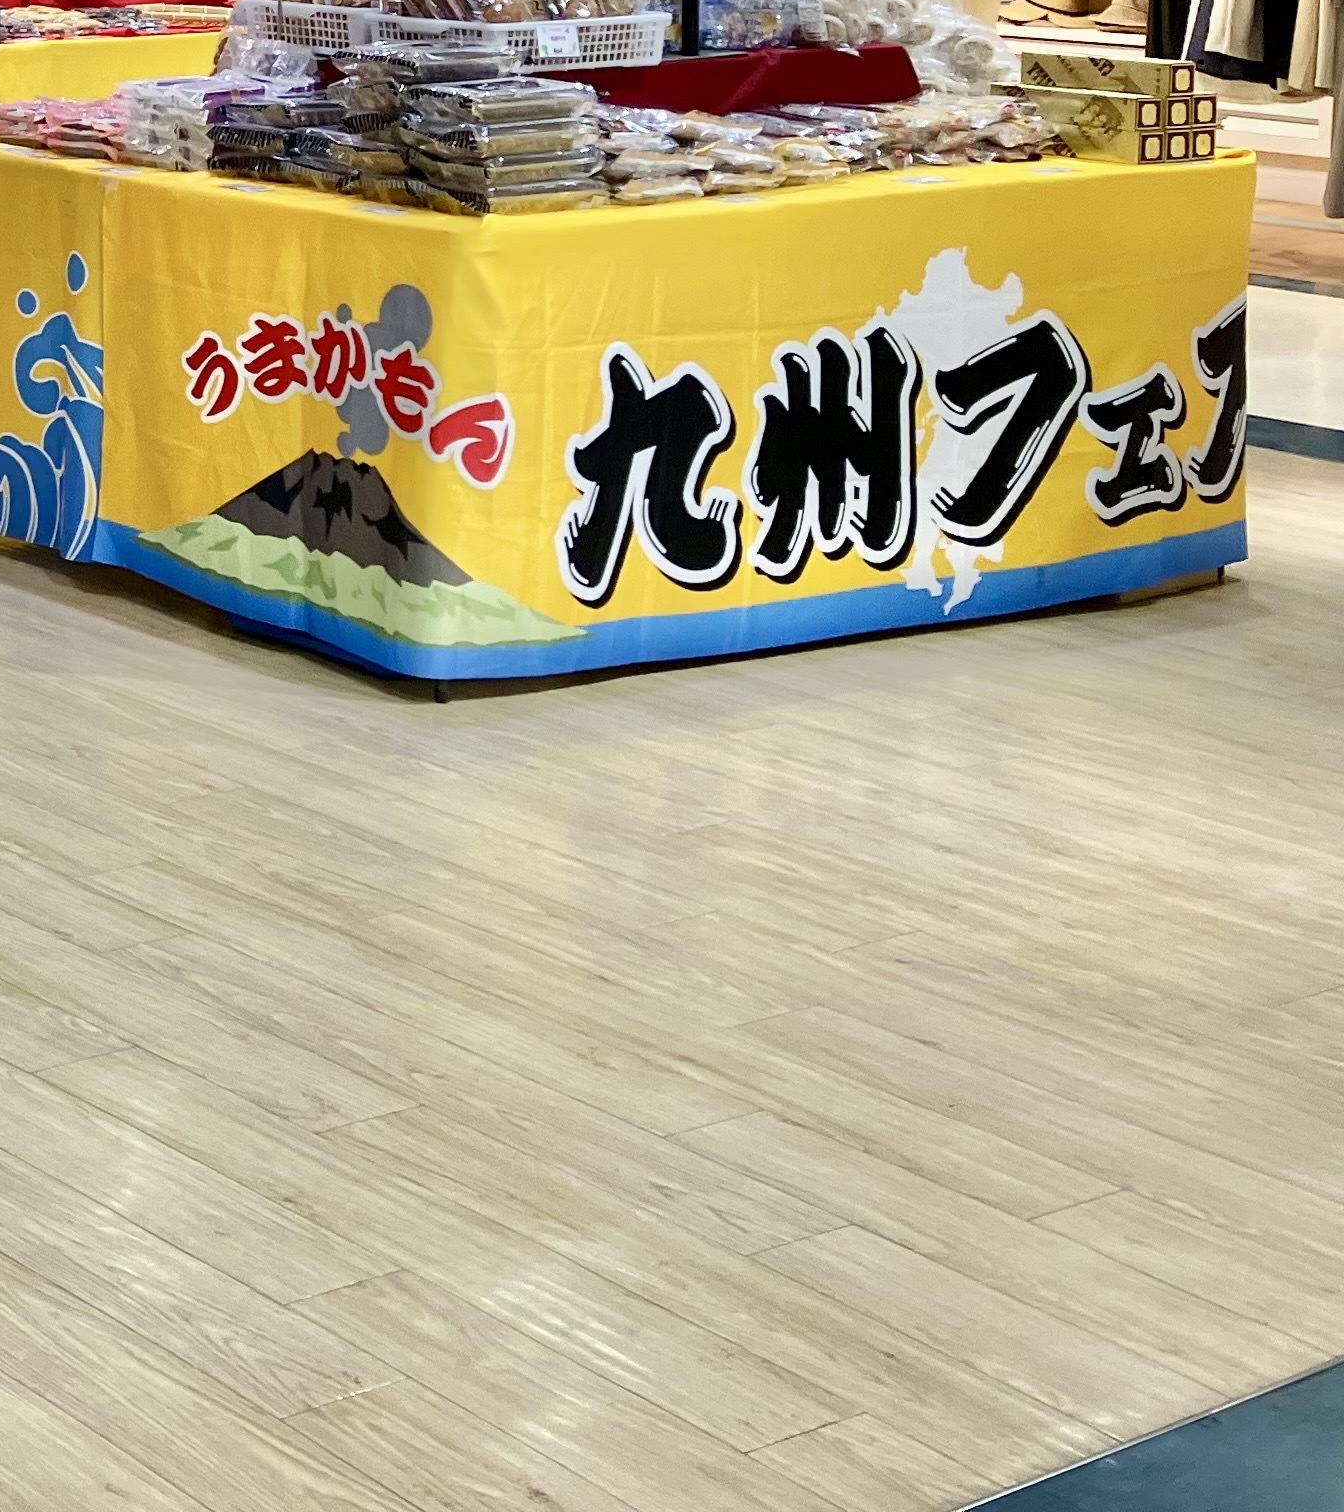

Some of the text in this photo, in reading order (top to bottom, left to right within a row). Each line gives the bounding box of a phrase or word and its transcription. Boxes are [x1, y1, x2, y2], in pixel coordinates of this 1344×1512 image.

[181, 311, 514, 488] うまかもん
